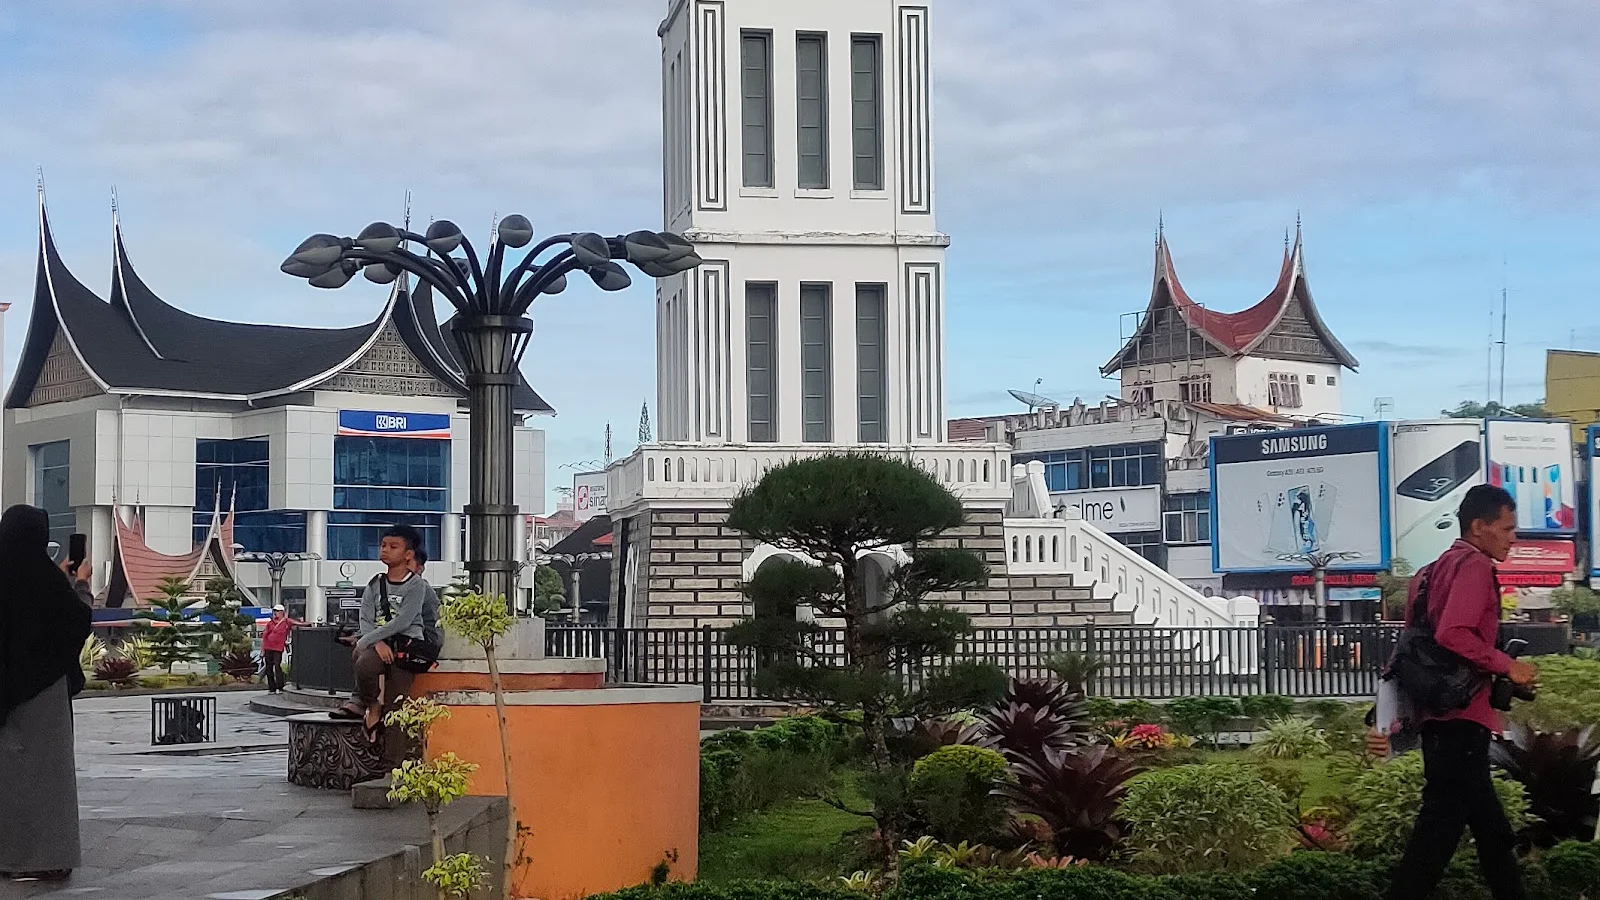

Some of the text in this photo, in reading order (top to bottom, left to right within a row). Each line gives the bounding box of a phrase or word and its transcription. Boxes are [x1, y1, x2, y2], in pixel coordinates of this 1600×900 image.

[388, 416, 407, 429] BRI
[1261, 434, 1328, 455] SAMSUNG
[1052, 498, 1114, 521] relme
